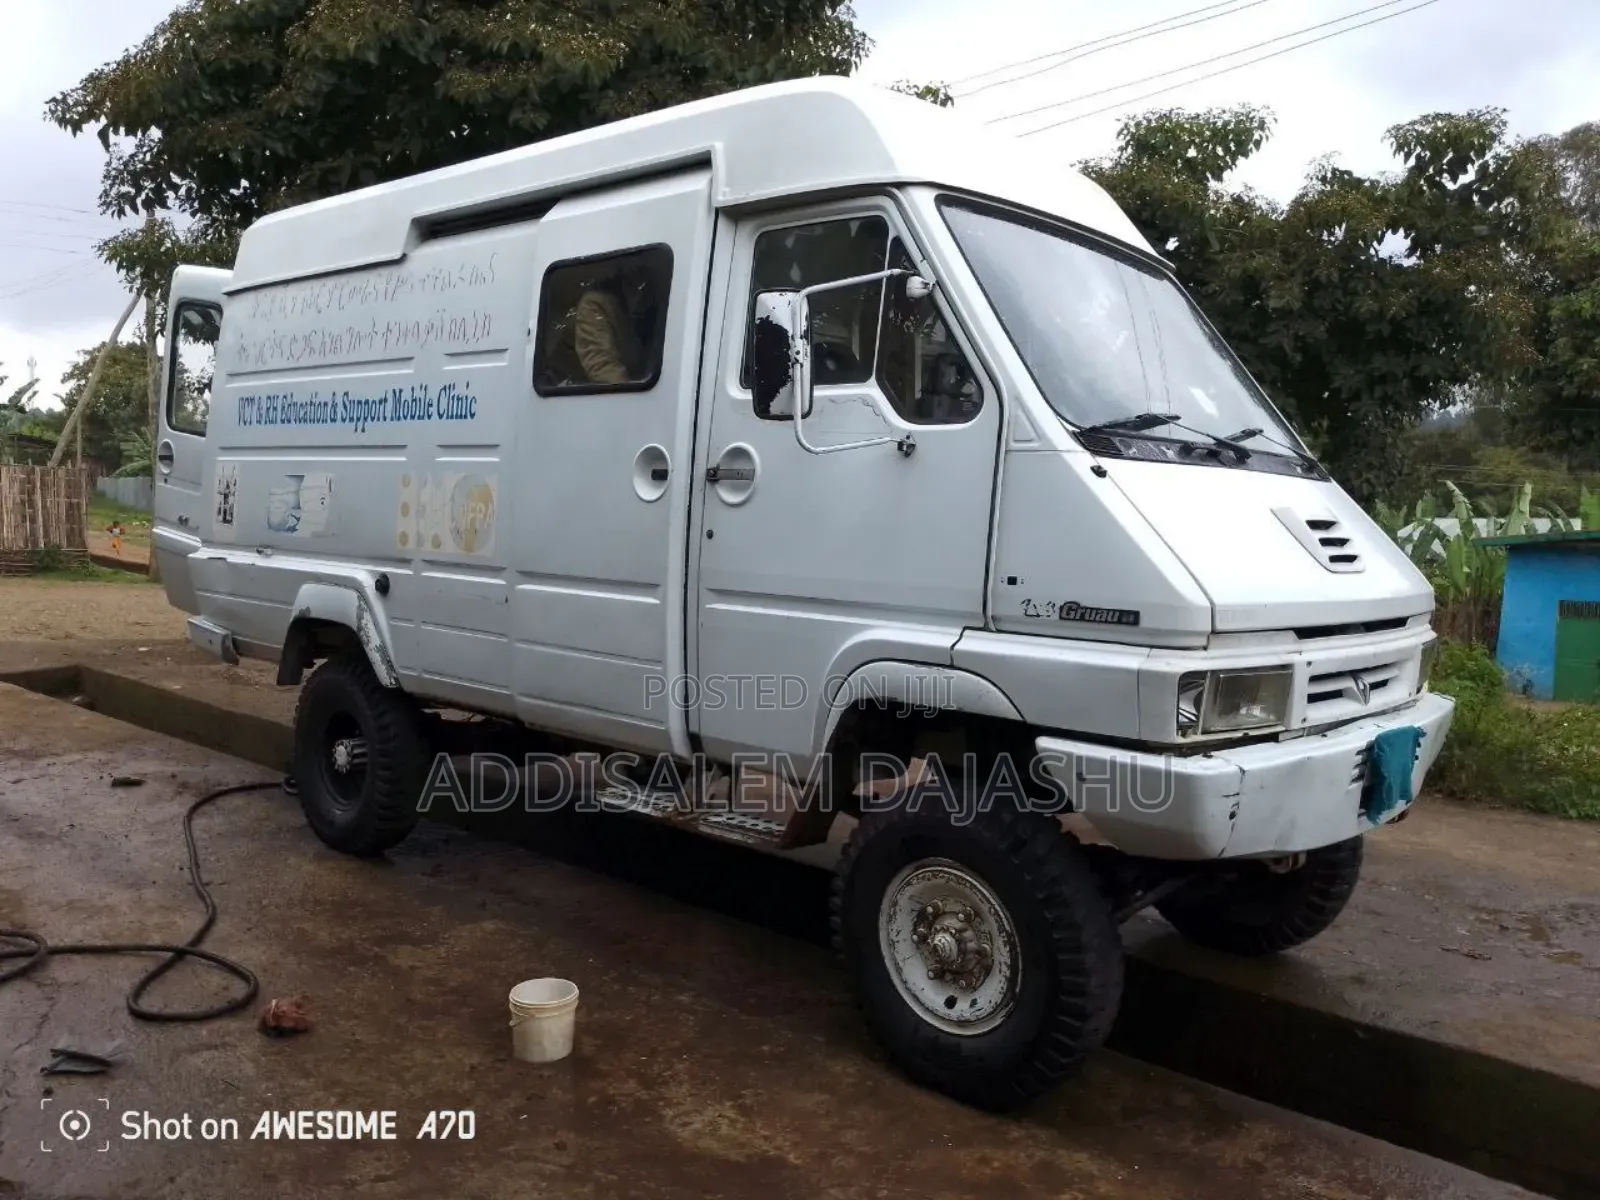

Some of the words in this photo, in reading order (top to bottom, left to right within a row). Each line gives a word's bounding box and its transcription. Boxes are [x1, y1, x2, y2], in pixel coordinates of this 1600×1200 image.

[237, 396, 256, 427] VCT
[264, 394, 280, 425] RH
[340, 390, 388, 433] Support
[390, 384, 434, 422] Mobile
[436, 381, 477, 421] Clinic
[1060, 602, 1120, 622] Gruau
